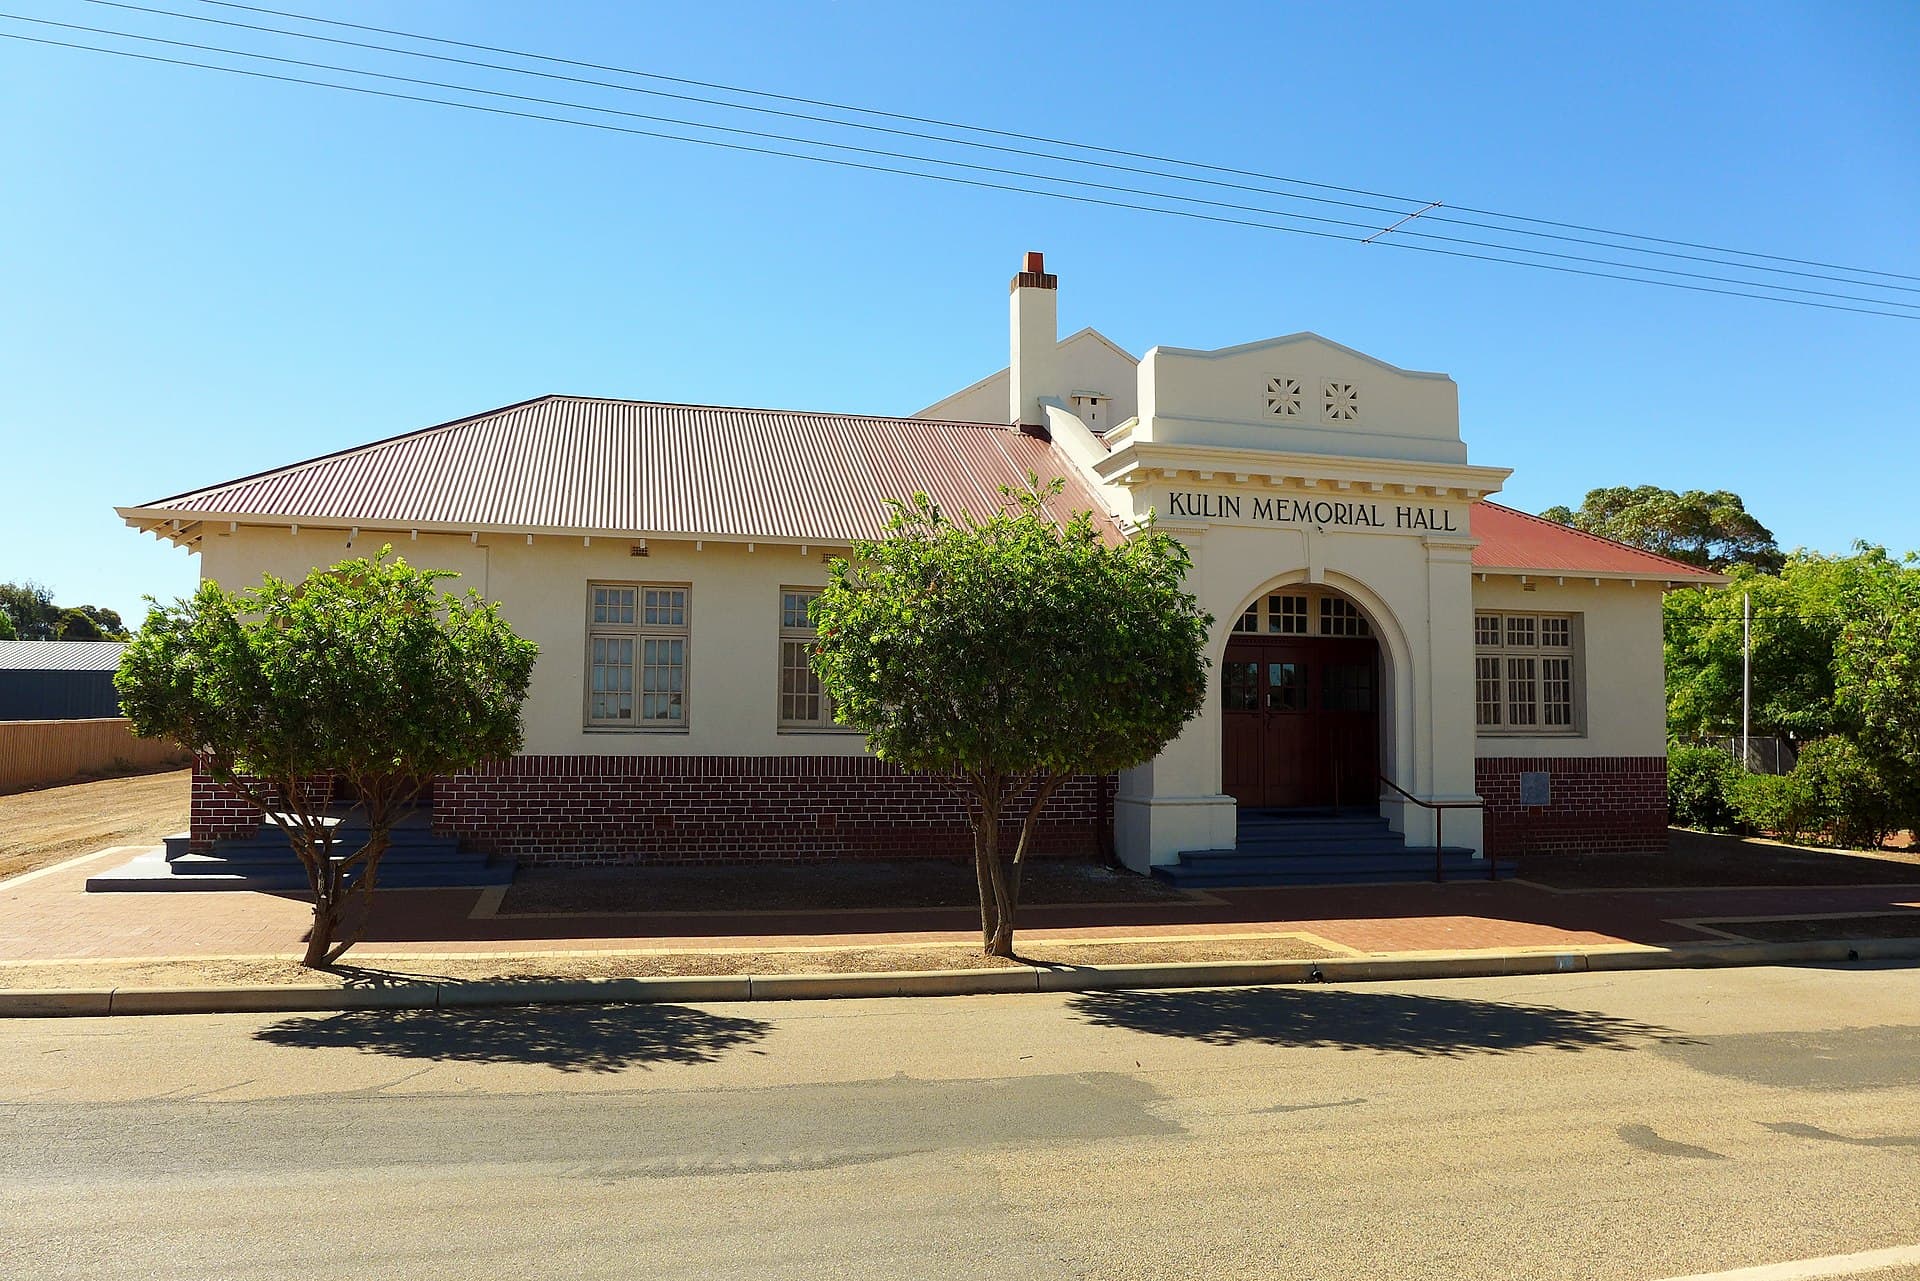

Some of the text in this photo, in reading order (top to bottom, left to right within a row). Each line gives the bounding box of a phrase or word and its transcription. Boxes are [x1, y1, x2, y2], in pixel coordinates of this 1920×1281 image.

[1169, 492, 1457, 531] KULIN MEMORIAL HALL
